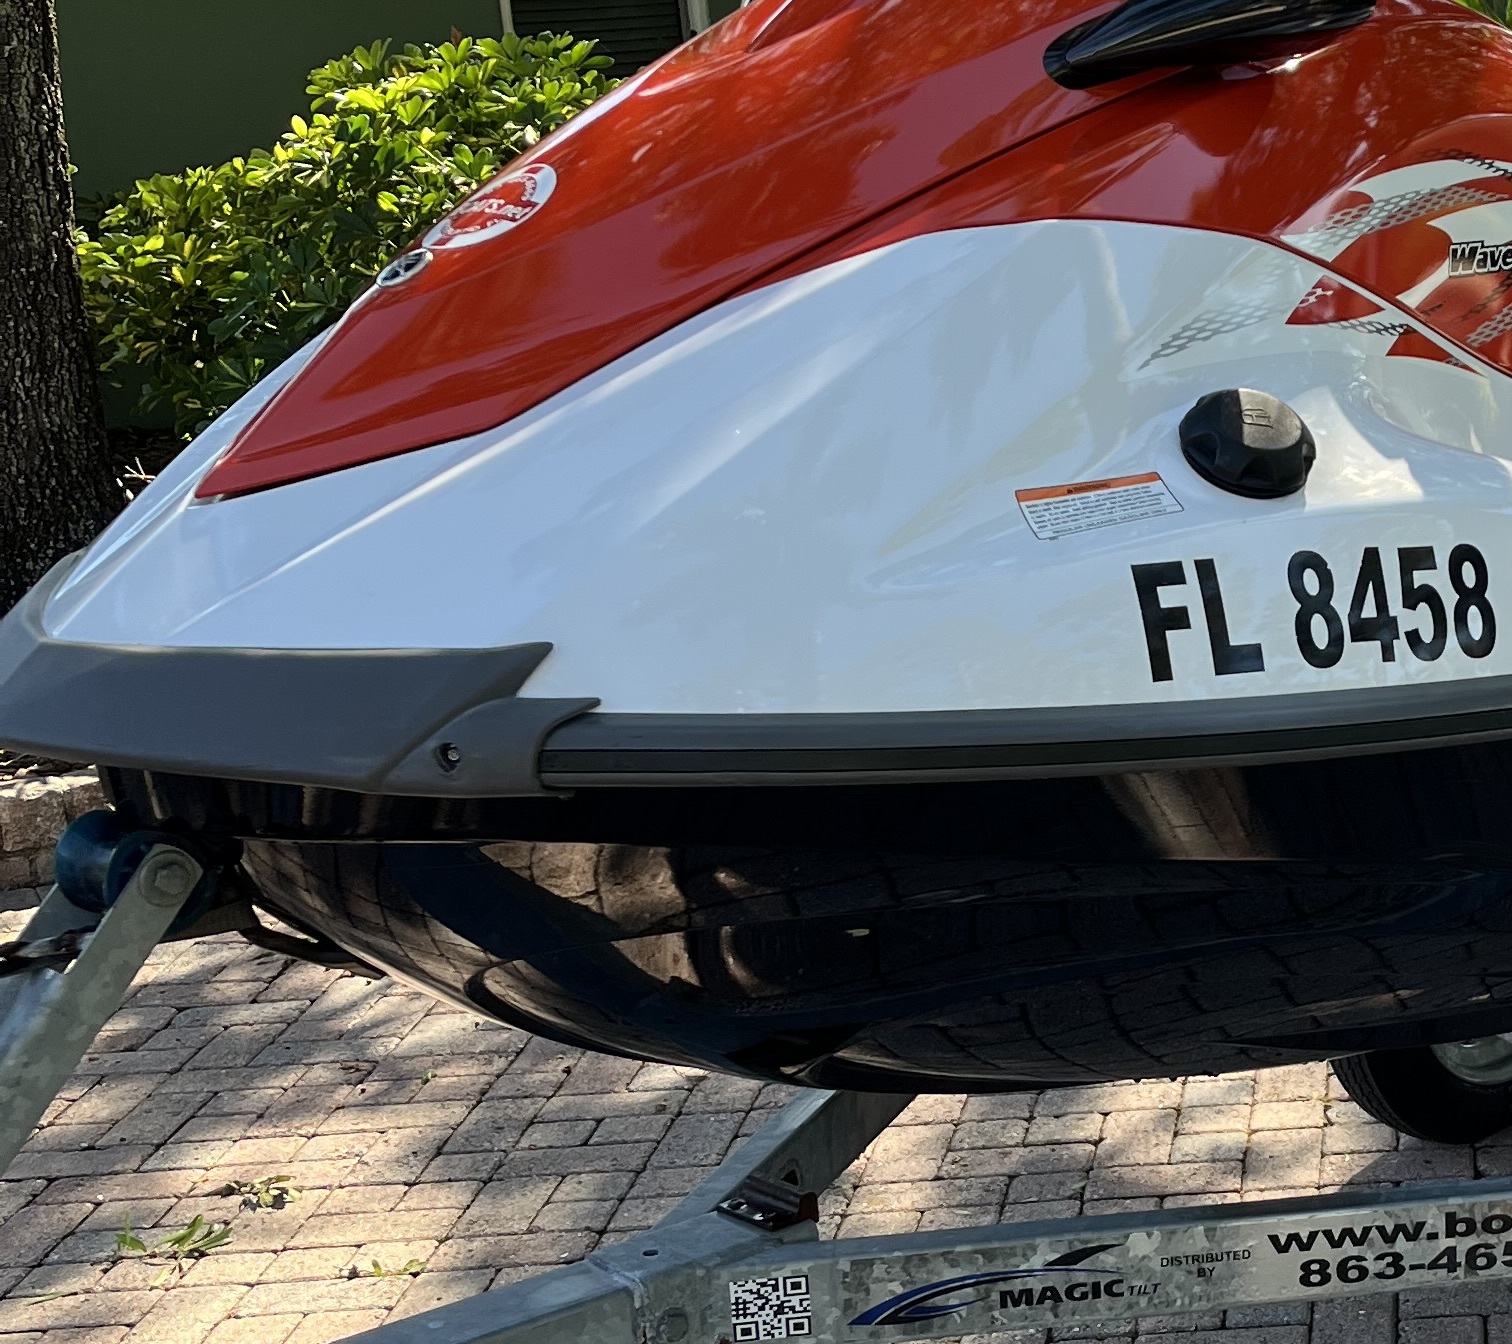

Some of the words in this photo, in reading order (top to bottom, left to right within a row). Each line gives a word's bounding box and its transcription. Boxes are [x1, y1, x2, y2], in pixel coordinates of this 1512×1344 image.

[1131, 558, 1265, 682] FL
[1286, 543, 1497, 668] 8458
[1160, 1249, 1251, 1268] DISTRIBUTED
[1197, 1266, 1216, 1278] BY
[999, 1278, 1125, 1310] MAGIC
[1126, 1281, 1162, 1299] TILT
